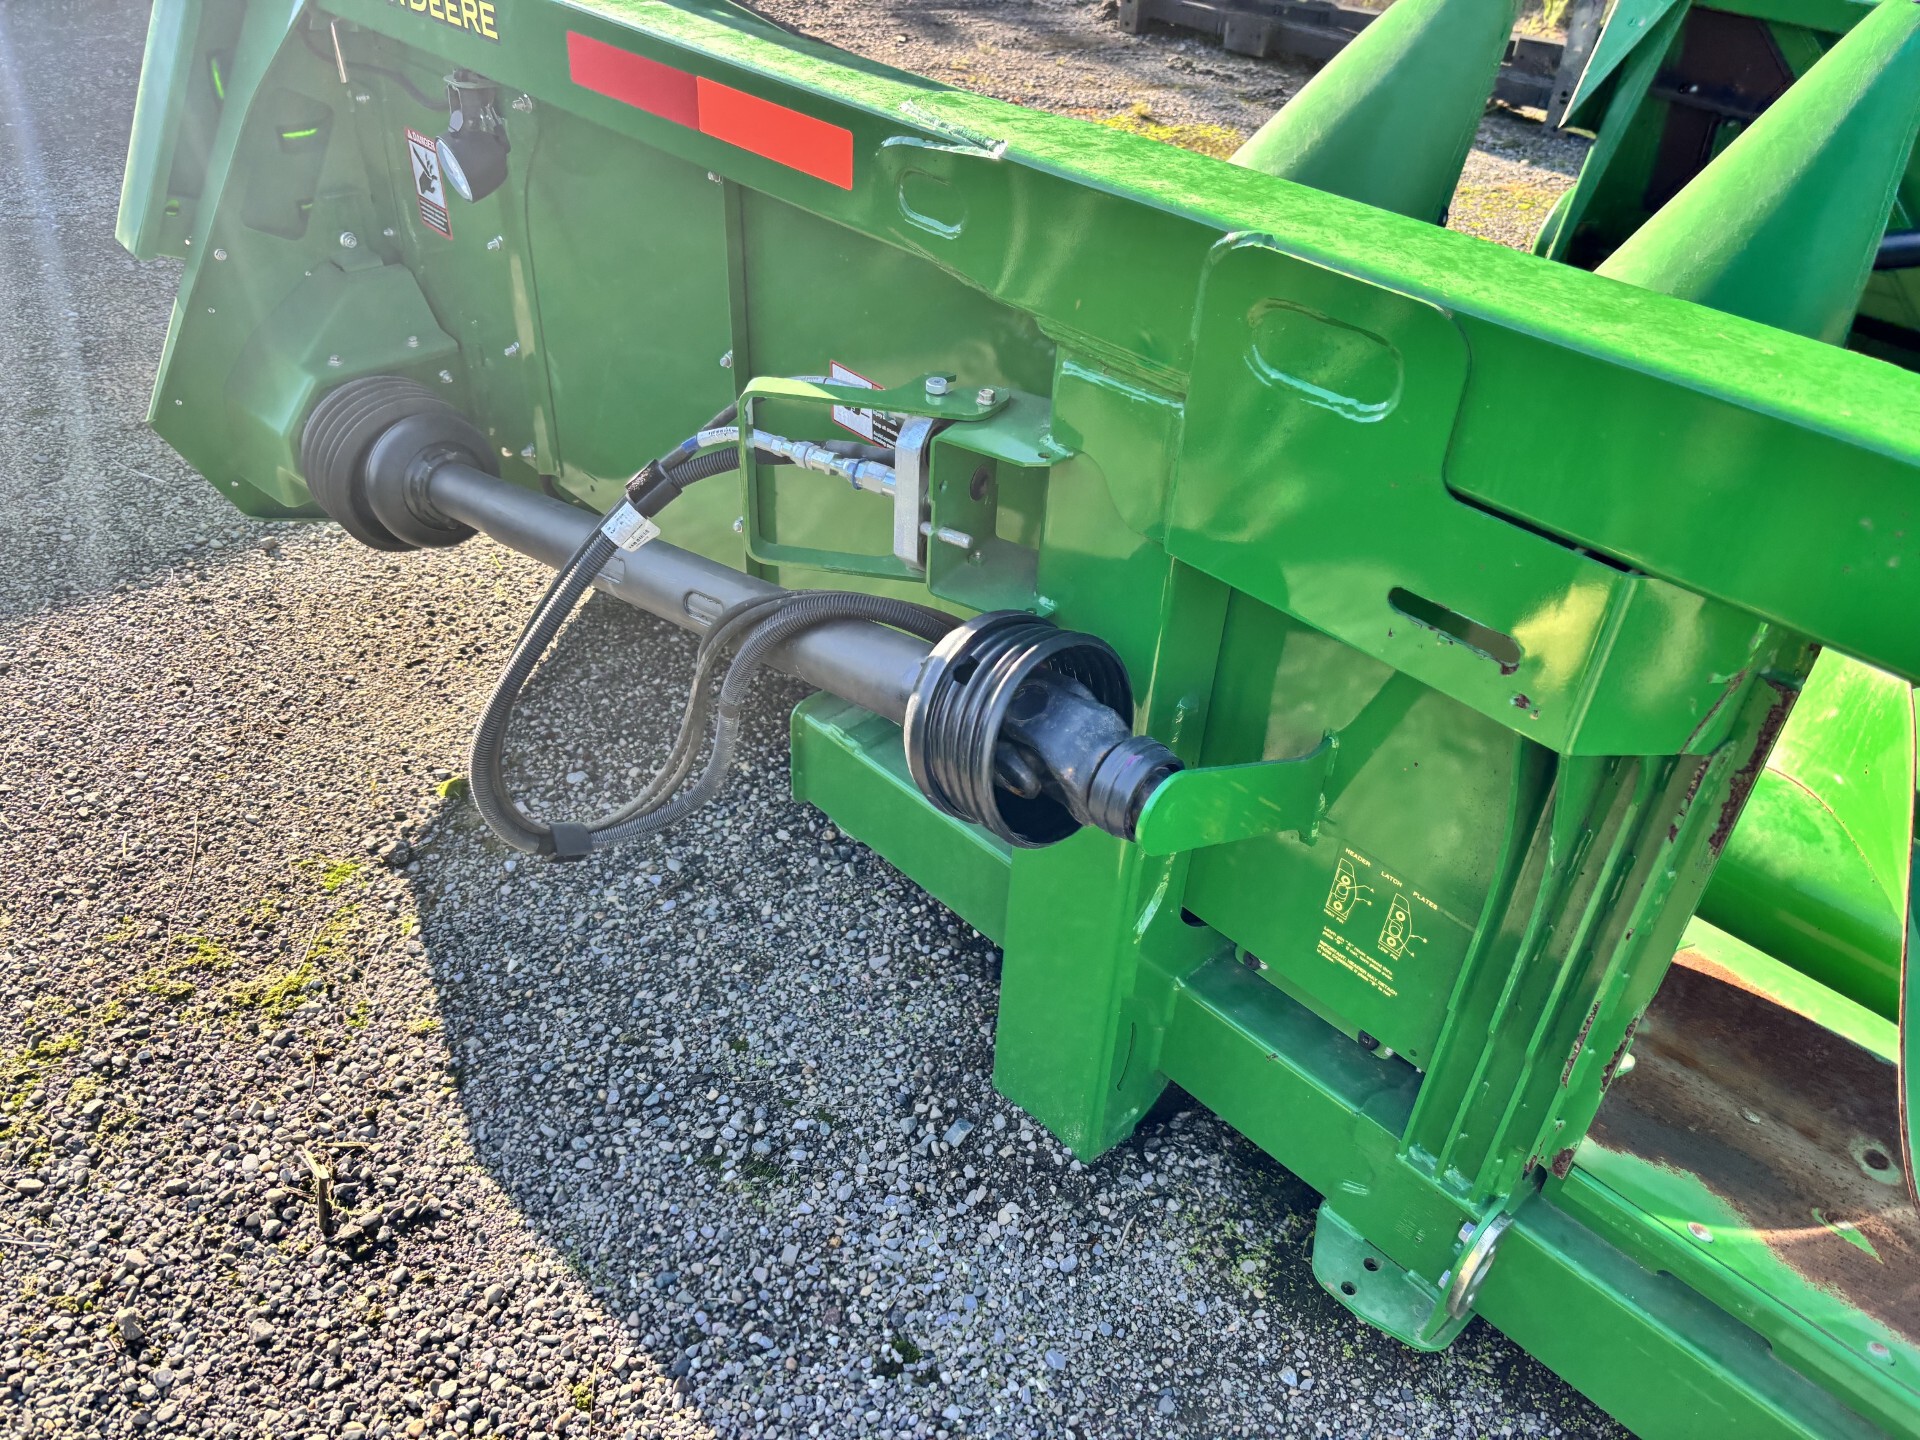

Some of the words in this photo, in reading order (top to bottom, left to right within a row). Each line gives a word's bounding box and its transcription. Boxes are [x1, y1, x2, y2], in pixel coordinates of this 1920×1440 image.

[410, 0, 498, 40] EERE
[412, 131, 435, 151] DANGER
[1345, 848, 1371, 867] HEADER
[1381, 871, 1402, 887] LATCH
[1413, 891, 1438, 910] PLATES
[1318, 944, 1332, 956] FROM
[1332, 954, 1354, 971] COMBINE
[1357, 972, 1369, 981] plate
[1322, 931, 1334, 940] plate
[1359, 955, 1370, 964] turn
[1369, 963, 1382, 973] plate
[1324, 926, 1336, 936] Latch
[1366, 955, 1382, 968] extend
[1377, 945, 1389, 954] LOW
[1318, 940, 1347, 961] IMPORTANT:
[1347, 959, 1367, 975] HEADER
[1366, 972, 1378, 982] MAY
[1377, 980, 1397, 996] DETACH
